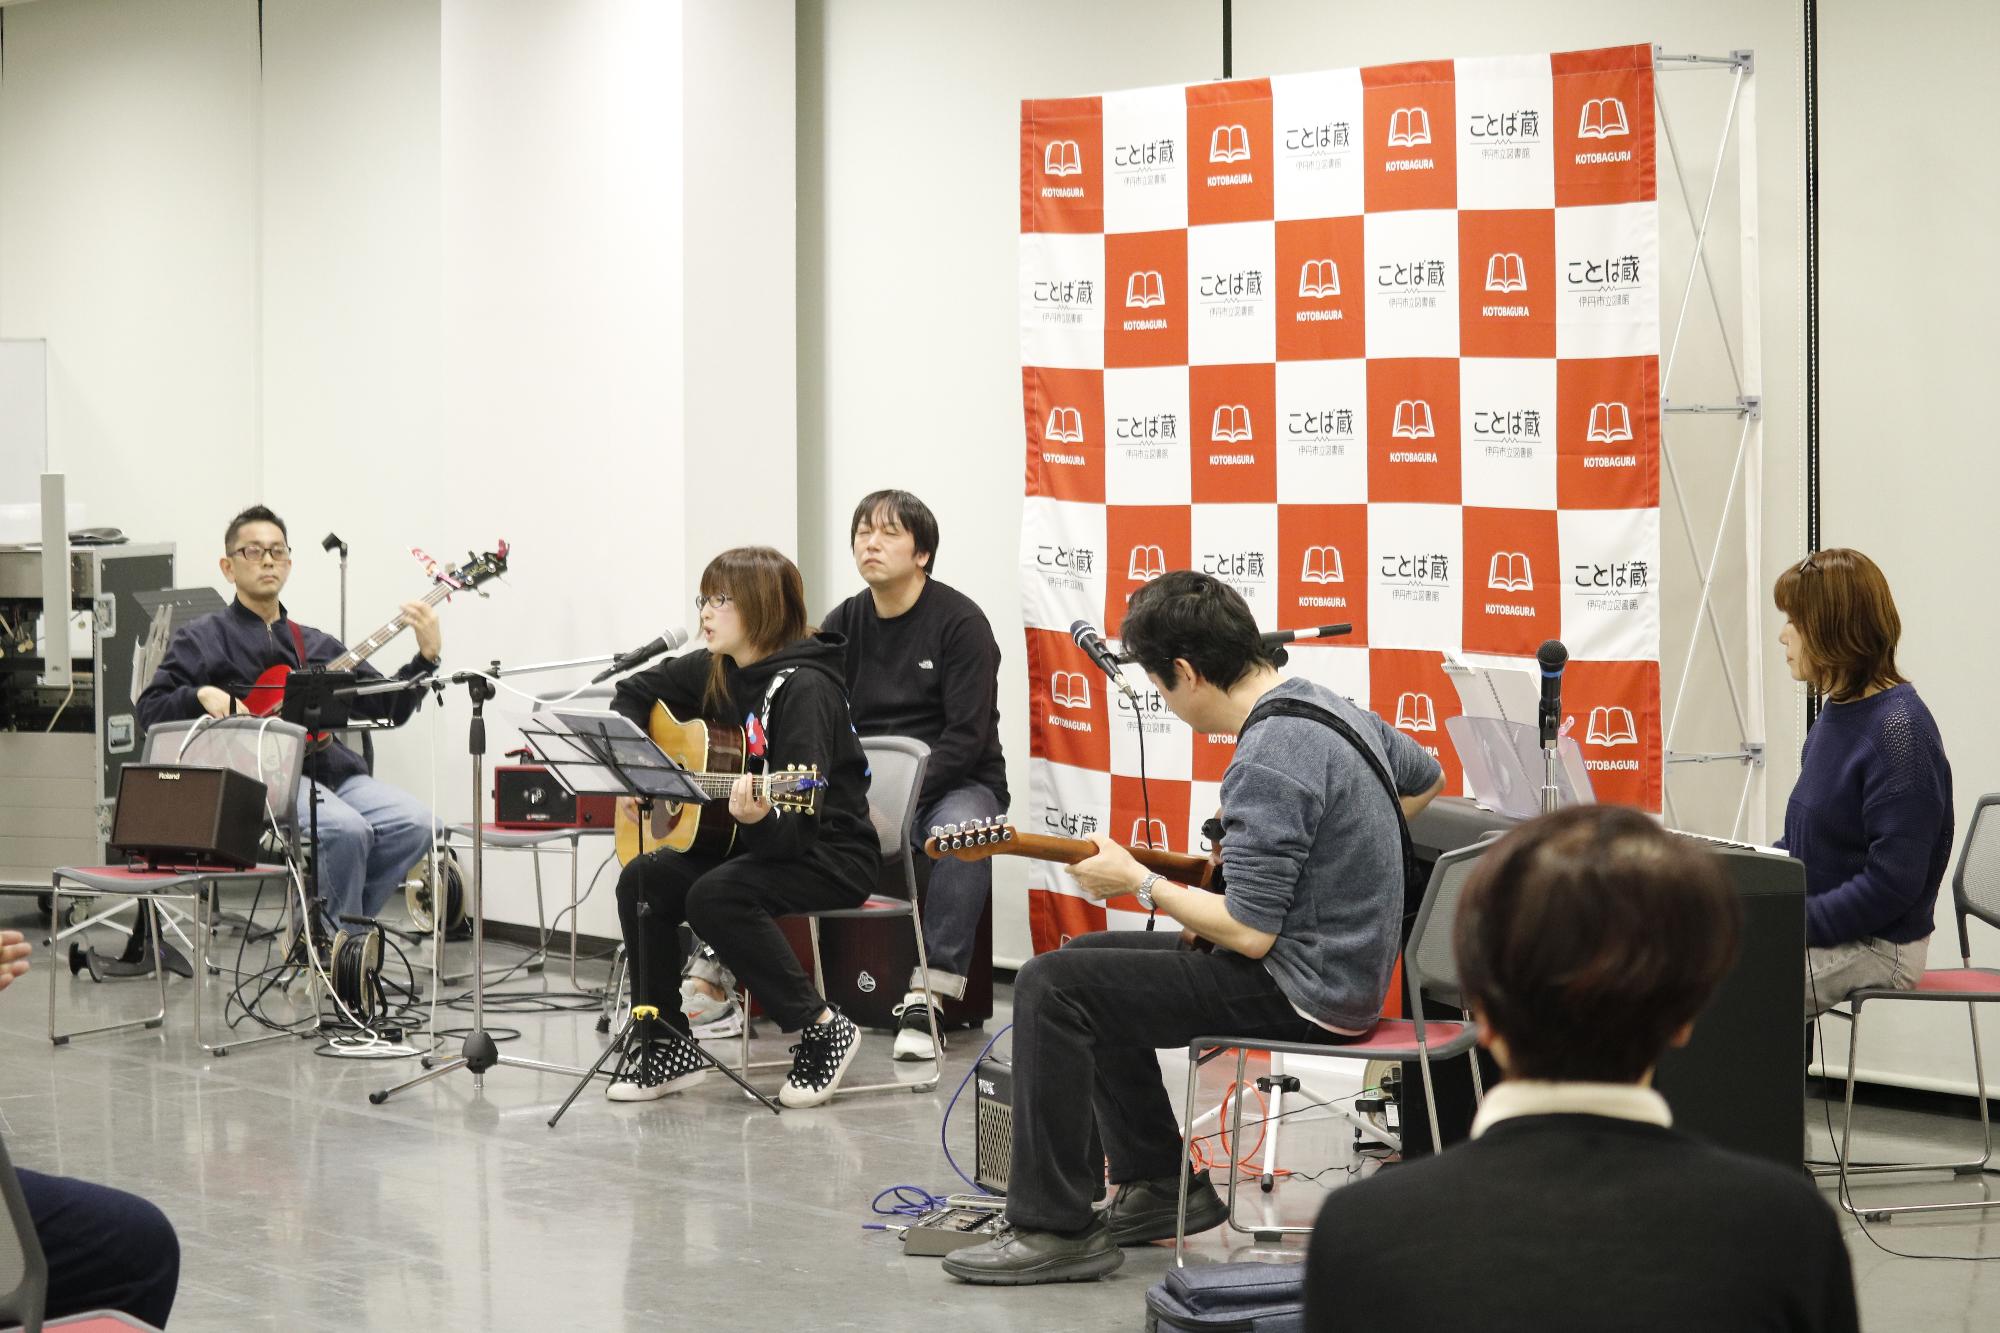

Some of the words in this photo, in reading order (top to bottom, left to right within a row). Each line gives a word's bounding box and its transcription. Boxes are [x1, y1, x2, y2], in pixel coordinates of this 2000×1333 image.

[1287, 122, 1349, 149] ことば蔵
[1471, 110, 1538, 138] ことば蔵
[1115, 139, 1174, 166] ことば蔵
[1575, 151, 1632, 164] KOTOBAGURA
[1386, 159, 1434, 171] KOTOBAGURA
[1207, 174, 1253, 186] KOTOBAGURA
[1379, 260, 1444, 286] ことば蔵
[1569, 255, 1639, 284] ことば蔵
[1034, 280, 1093, 303] ことば蔵
[1201, 271, 1262, 296] ことば蔵
[1296, 310, 1343, 321] KOTOBAGURA
[1483, 306, 1529, 316] KOTOBAGURA
[1123, 319, 1167, 331] KOTOBAGURA
[1117, 414, 1176, 438] ことば蔵
[1289, 409, 1352, 436] ことば蔵
[1475, 410, 1540, 439] ことば蔵
[1210, 455, 1255, 465] KOTOBAGURA
[1390, 452, 1437, 462] KOTOBAGURA
[1584, 456, 1637, 467] KOTOBAGURA
[1203, 552, 1264, 577] ことば蔵
[1382, 554, 1448, 581] ことば蔵
[1575, 561, 1647, 589] ことば蔵
[1299, 596, 1346, 607] KOTOBAGURA
[1485, 604, 1535, 616] KOTOBAGURA
[1209, 734, 1237, 744] KOTOBA
